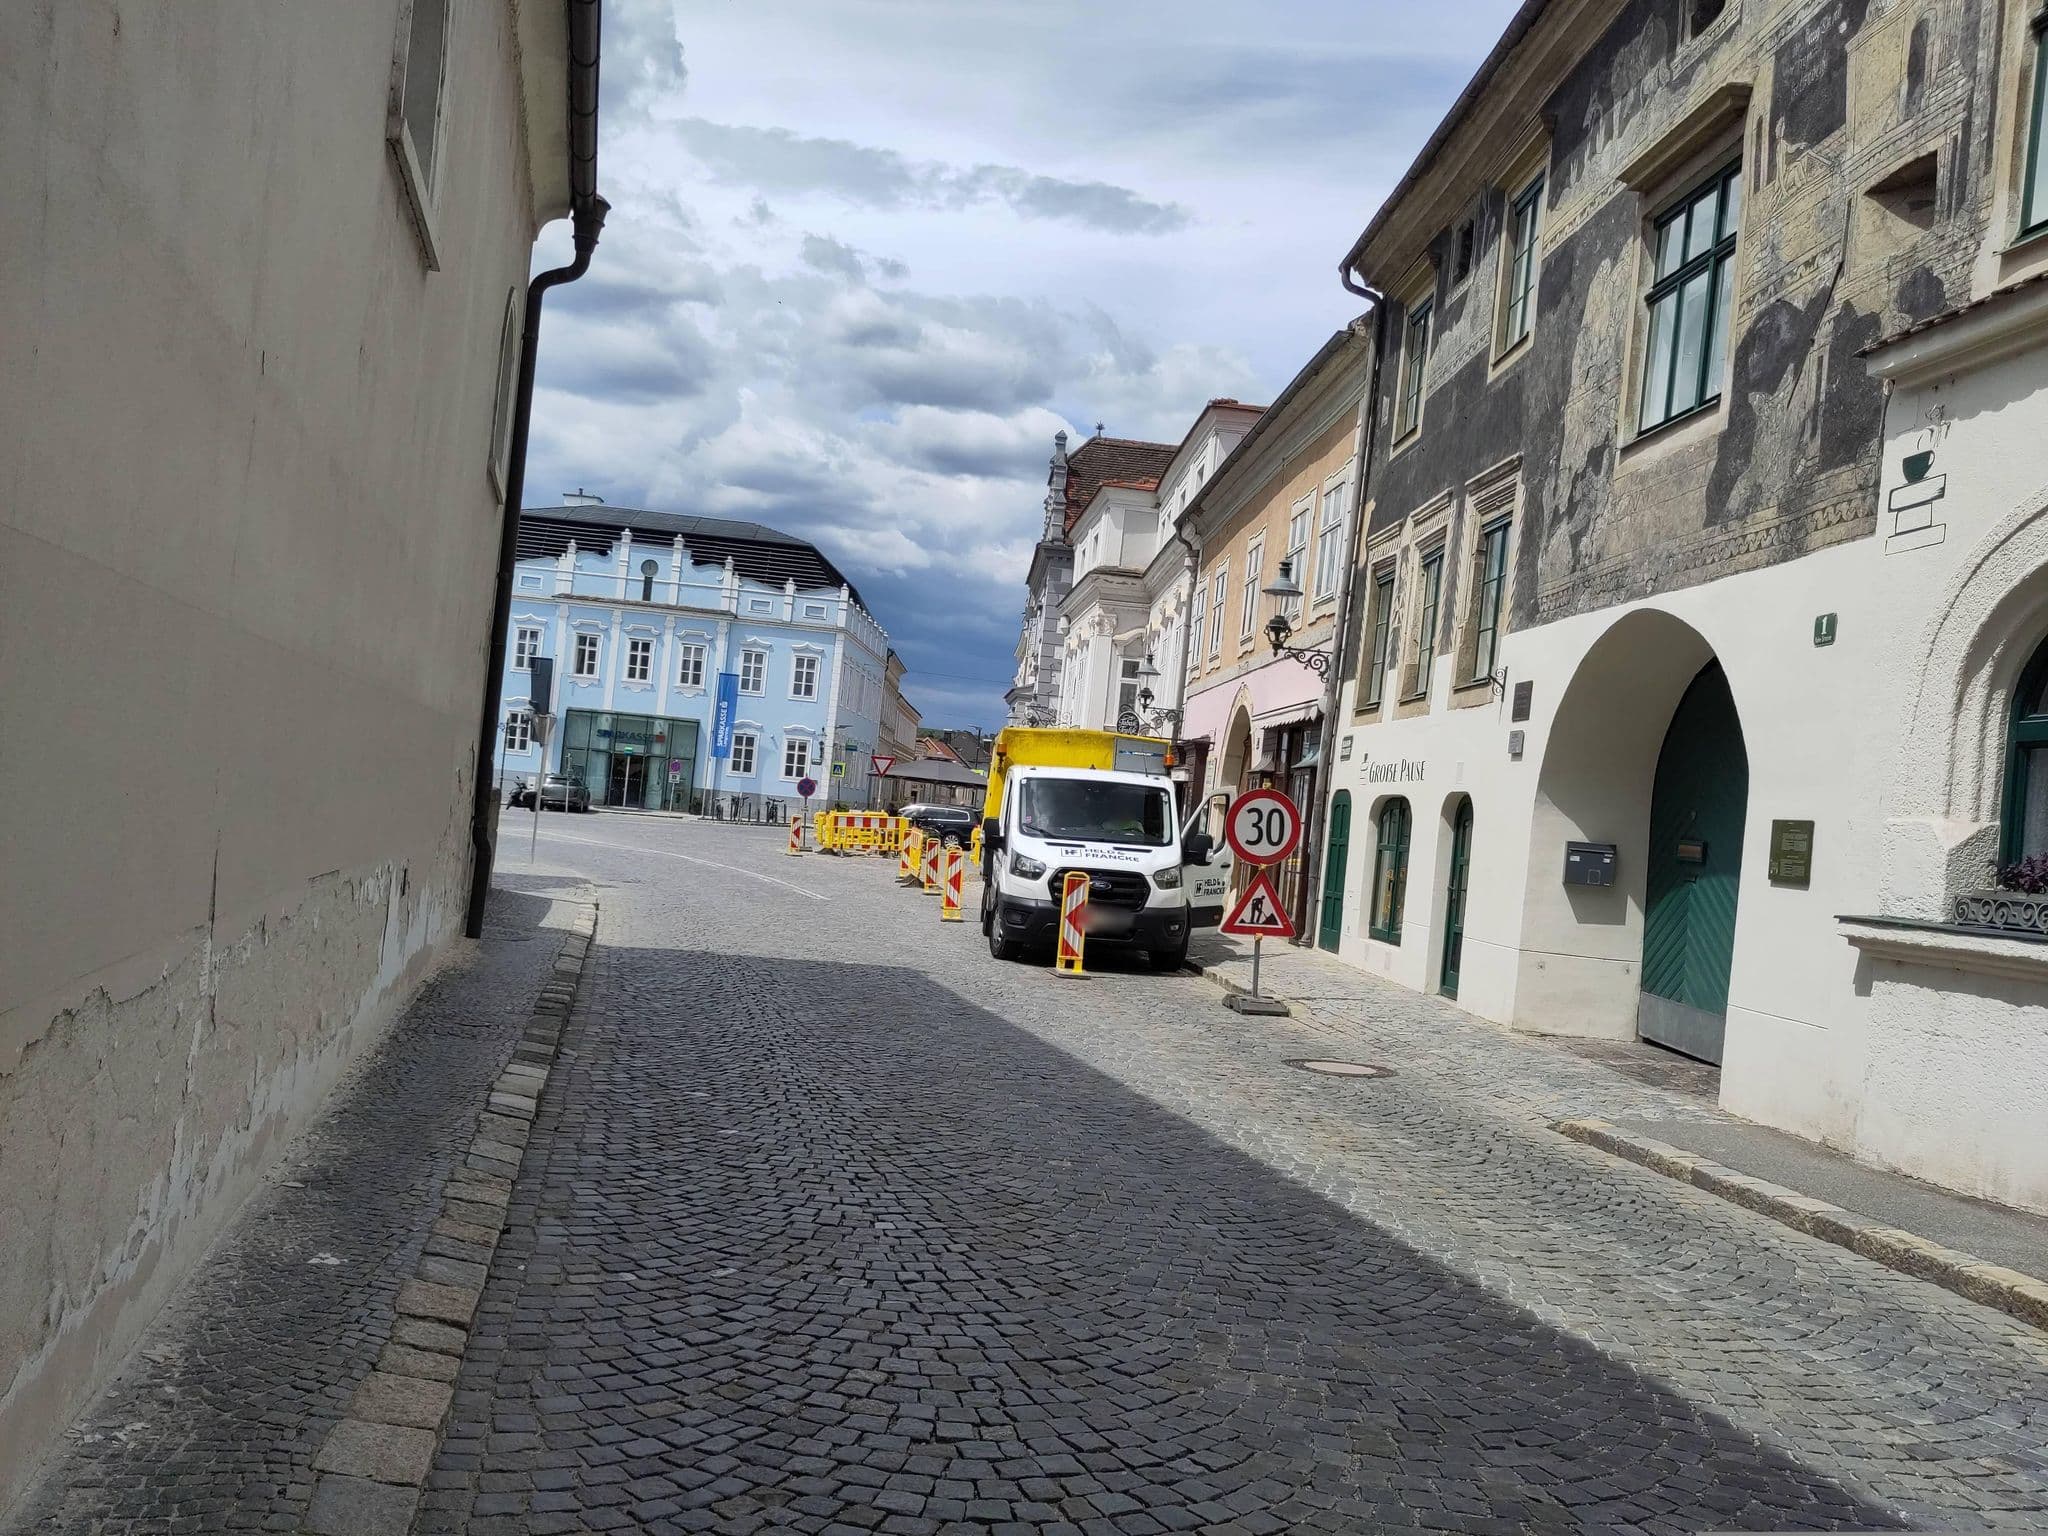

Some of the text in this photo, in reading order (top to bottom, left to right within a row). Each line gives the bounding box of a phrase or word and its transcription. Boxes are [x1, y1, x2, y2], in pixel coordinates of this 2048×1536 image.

[1821, 615, 1828, 635] 1
[717, 708, 727, 747] SPARKASSE
[1399, 758, 1426, 782] PAUSE
[1245, 807, 1285, 846] 30
[1085, 853, 1140, 863] FRANCKE
